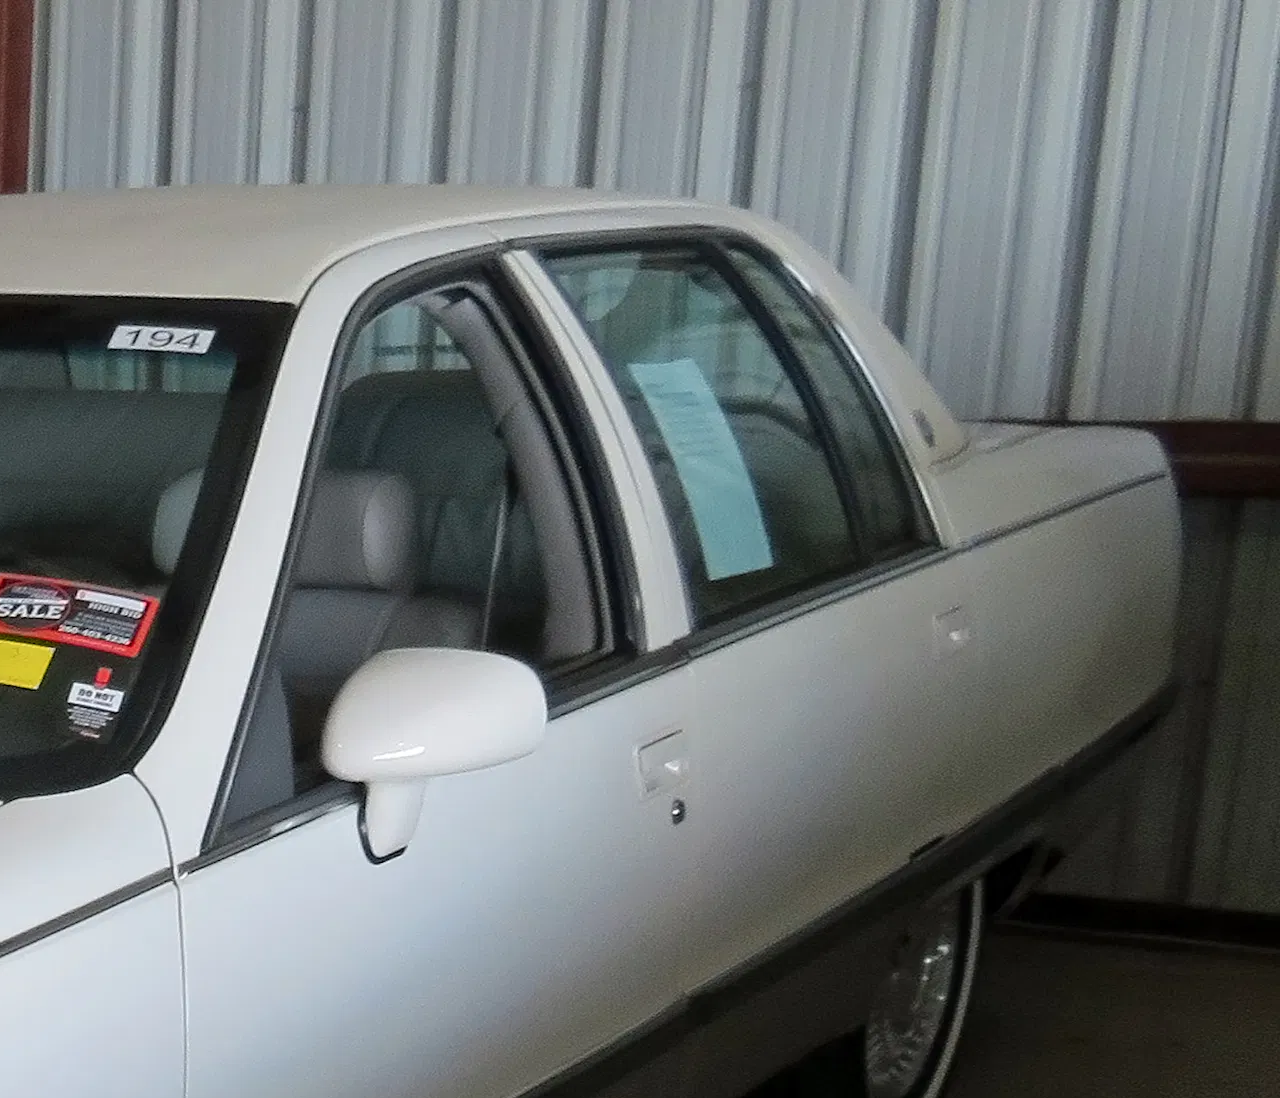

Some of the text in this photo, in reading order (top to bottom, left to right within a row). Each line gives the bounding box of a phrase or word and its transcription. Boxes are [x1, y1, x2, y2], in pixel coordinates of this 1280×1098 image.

[126, 328, 201, 349] 194
[87, 601, 143, 620] HIGH BID
[77, 688, 93, 699] DO
[94, 690, 117, 703] NOT
